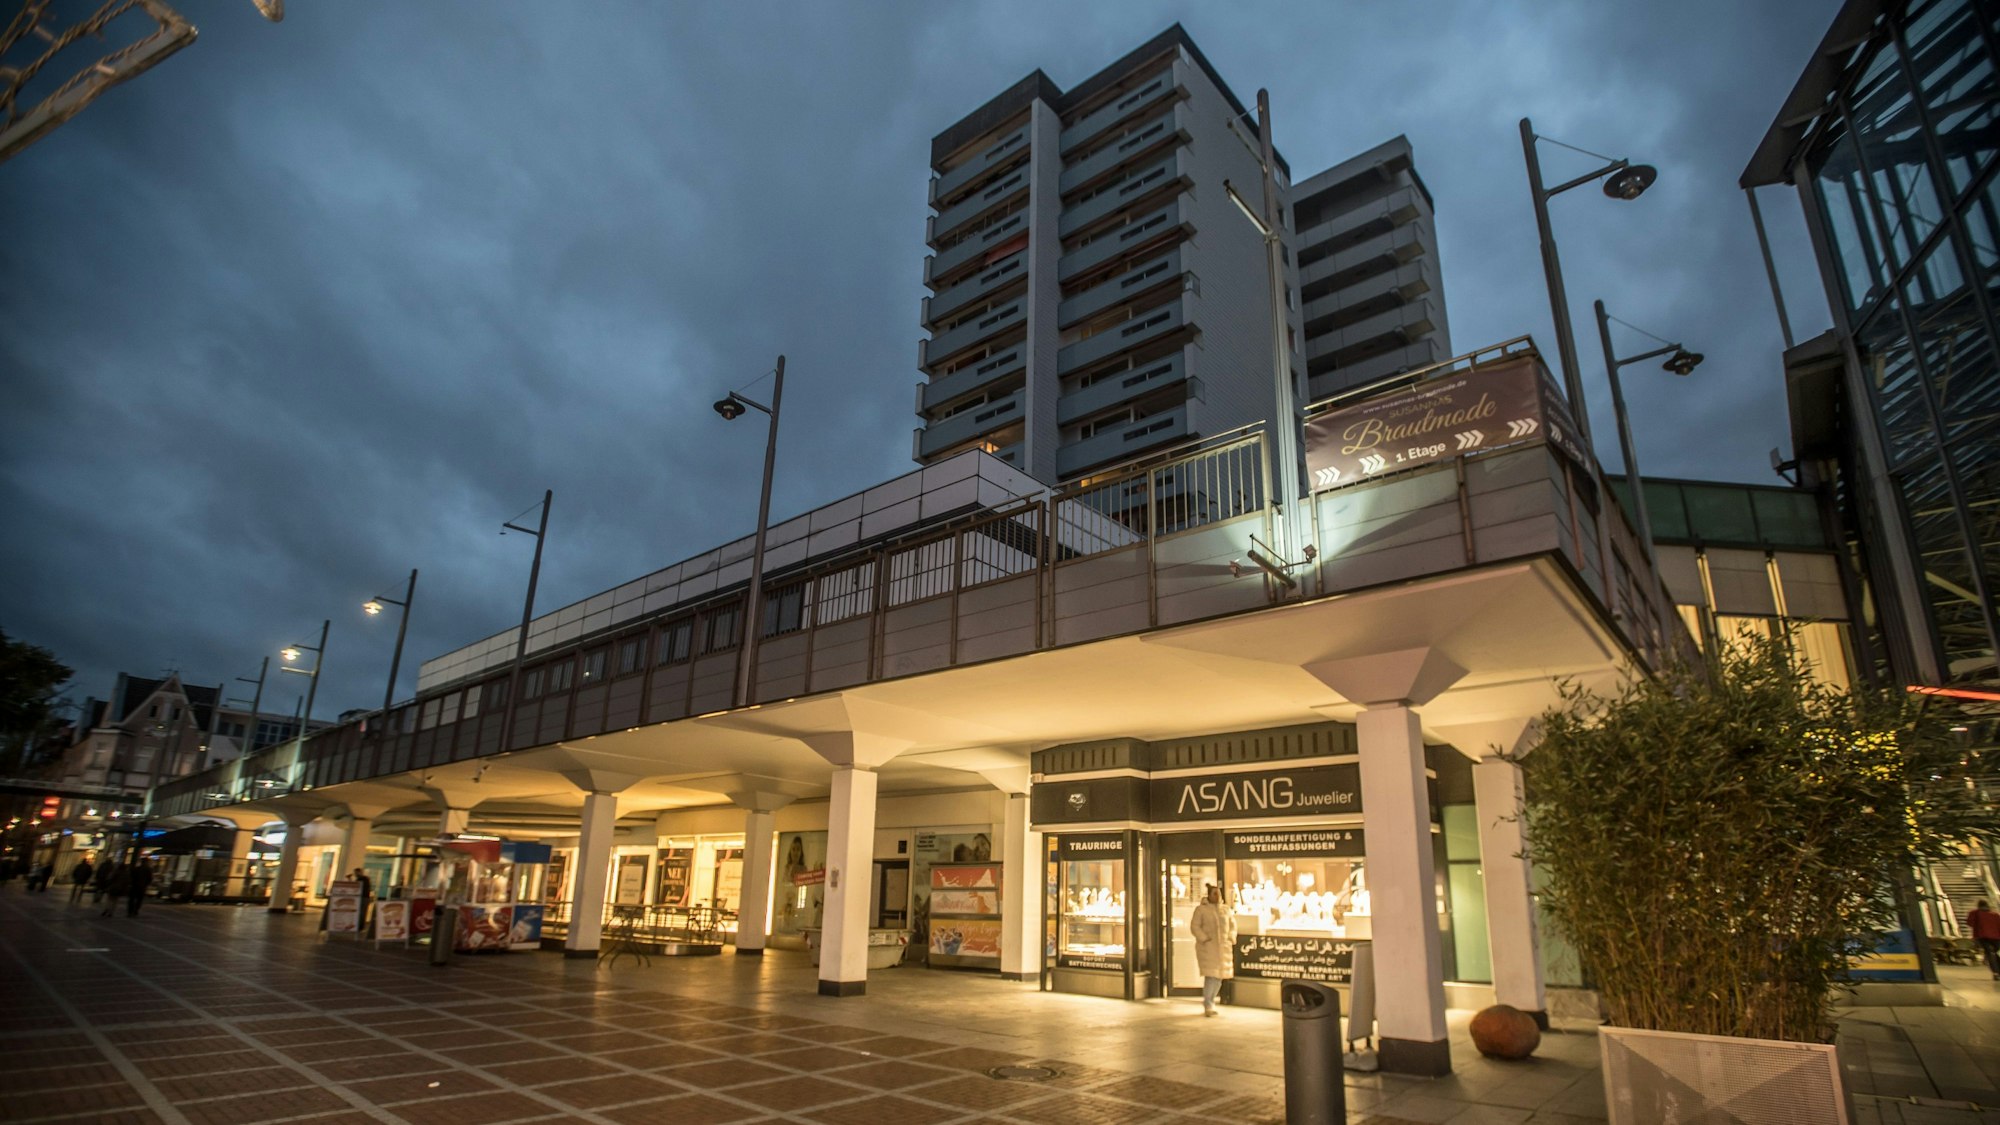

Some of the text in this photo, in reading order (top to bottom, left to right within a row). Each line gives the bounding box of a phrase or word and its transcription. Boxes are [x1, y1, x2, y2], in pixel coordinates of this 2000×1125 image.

[1389, 394, 1453, 419] SUSANNAS
[1341, 392, 1497, 455] Brautmode
[1396, 442, 1447, 463] 1. Etage
[1177, 776, 1353, 814] ASANG Juwelier
[1069, 840, 1123, 851] TRAURINGE
[1234, 831, 1353, 844] SONDERANFERTIGUNG &
[1249, 841, 1336, 853] STEINFASSUNGEN
[1261, 970, 1300, 979] GRAVUREN
[1302, 972, 1326, 980] ALLER
